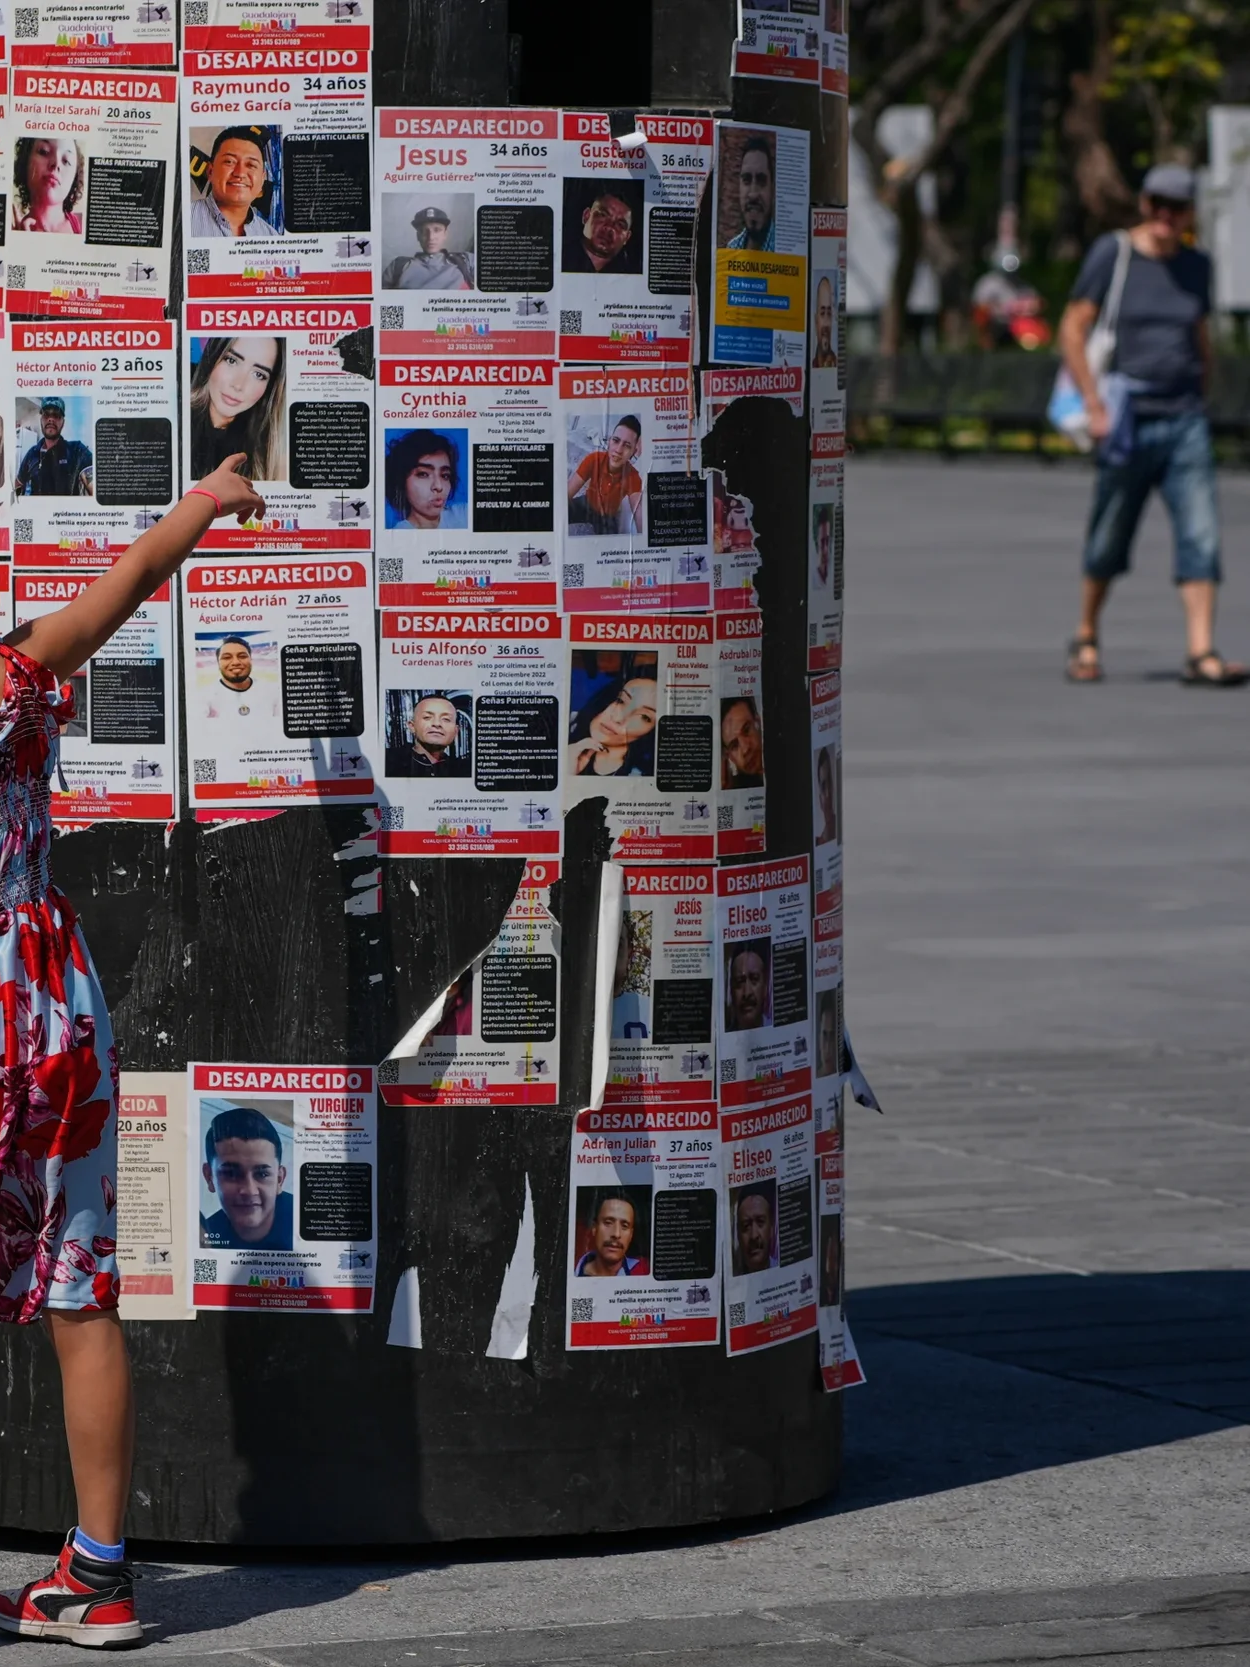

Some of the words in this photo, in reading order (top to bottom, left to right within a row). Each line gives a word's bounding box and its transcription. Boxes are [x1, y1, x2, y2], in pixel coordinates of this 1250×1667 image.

[198, 50, 357, 69] DESAPARECIDO
[26, 77, 161, 98] DESAPARECIDA
[193, 79, 290, 98] Raymundo
[304, 77, 321, 90] 34
[327, 77, 366, 90] años
[15, 104, 41, 113] María
[45, 105, 65, 114] Itzel
[69, 106, 100, 115] Sarahí
[191, 100, 239, 113] Gómez
[245, 99, 291, 112] García
[106, 108, 120, 117] 20
[123, 108, 151, 119] años
[25, 120, 55, 130] García
[58, 122, 90, 132] Ochoa
[395, 119, 544, 135] DESAPARECIDO
[578, 118, 704, 138] DESARECIDO
[287, 133, 310, 141] SEÑAS
[490, 144, 508, 156] 34
[512, 143, 547, 157] años
[396, 145, 468, 170] Jesus
[582, 160, 608, 169] Lopez
[610, 160, 647, 169] Mariscal
[662, 154, 675, 166] 36
[678, 155, 704, 168] años
[384, 173, 423, 183] Aguirre
[426, 171, 474, 182] Gutiérrez
[728, 261, 759, 273] PERSONA
[761, 262, 799, 277] DESAPARECIDA
[200, 310, 357, 327] DESAPARECIDA
[23, 330, 161, 348] DESAPARECIDO
[309, 333, 343, 345] CITLA
[16, 362, 50, 372] Héctor
[53, 362, 96, 372] Antonio
[101, 358, 120, 371] 23
[125, 358, 163, 371] años
[394, 366, 546, 382] DESAPARECIDA
[17, 378, 54, 388] Quezada
[57, 378, 93, 387] Becerra
[712, 374, 796, 392] DESAPARECIDO
[514, 388, 530, 396] años
[401, 392, 467, 410] Cynthia
[654, 397, 690, 412] CRHISTI
[384, 410, 429, 419] González
[432, 410, 477, 418] González
[479, 444, 498, 452] SEÑAS
[201, 566, 352, 586] DESAPARECIDO
[190, 596, 238, 608] Héctor
[240, 595, 287, 607] Adrián
[298, 595, 310, 604] 27
[314, 594, 342, 603] años
[199, 612, 228, 624] Águila
[230, 614, 263, 622] Corona
[397, 616, 549, 632] DESAPARECIDO
[583, 622, 709, 640] DESAPARECIDA
[285, 645, 308, 654] Señas
[309, 644, 357, 653] Particulares
[392, 643, 423, 654] Luis
[428, 642, 487, 654] Alfonso
[497, 646, 510, 655] 36
[513, 645, 539, 655] años
[677, 645, 696, 659] ELDA
[447, 658, 473, 666] Flores
[624, 875, 708, 891] PARECIDO
[727, 867, 803, 892] DESAPARECIDO
[779, 894, 788, 904] 66
[790, 892, 800, 903] años
[674, 898, 702, 915] JESÚS
[728, 905, 767, 925] Eliseo
[498, 934, 520, 943] Mayo
[723, 926, 749, 939] Flores
[751, 924, 771, 935] Rosas
[209, 1071, 362, 1089] DESAPARECIDO
[310, 1098, 364, 1113] YURGUEN
[118, 1120, 134, 1132] 20
[136, 1121, 167, 1132] años
[590, 1111, 711, 1128] DESAPARECIDO
[731, 1110, 807, 1138] DESAPARECIDO
[582, 1139, 622, 1149] Adrian
[624, 1139, 656, 1151] Julian
[670, 1141, 683, 1152] 37
[686, 1140, 712, 1151] años
[784, 1134, 790, 1145] 66
[577, 1154, 622, 1163] Martinez
[625, 1153, 660, 1165] Esparza
[734, 1149, 772, 1170] Eliseo
[728, 1169, 754, 1185] Flores
[756, 1165, 776, 1178] Rosas
[248, 1276, 306, 1289] MUNDIAL
